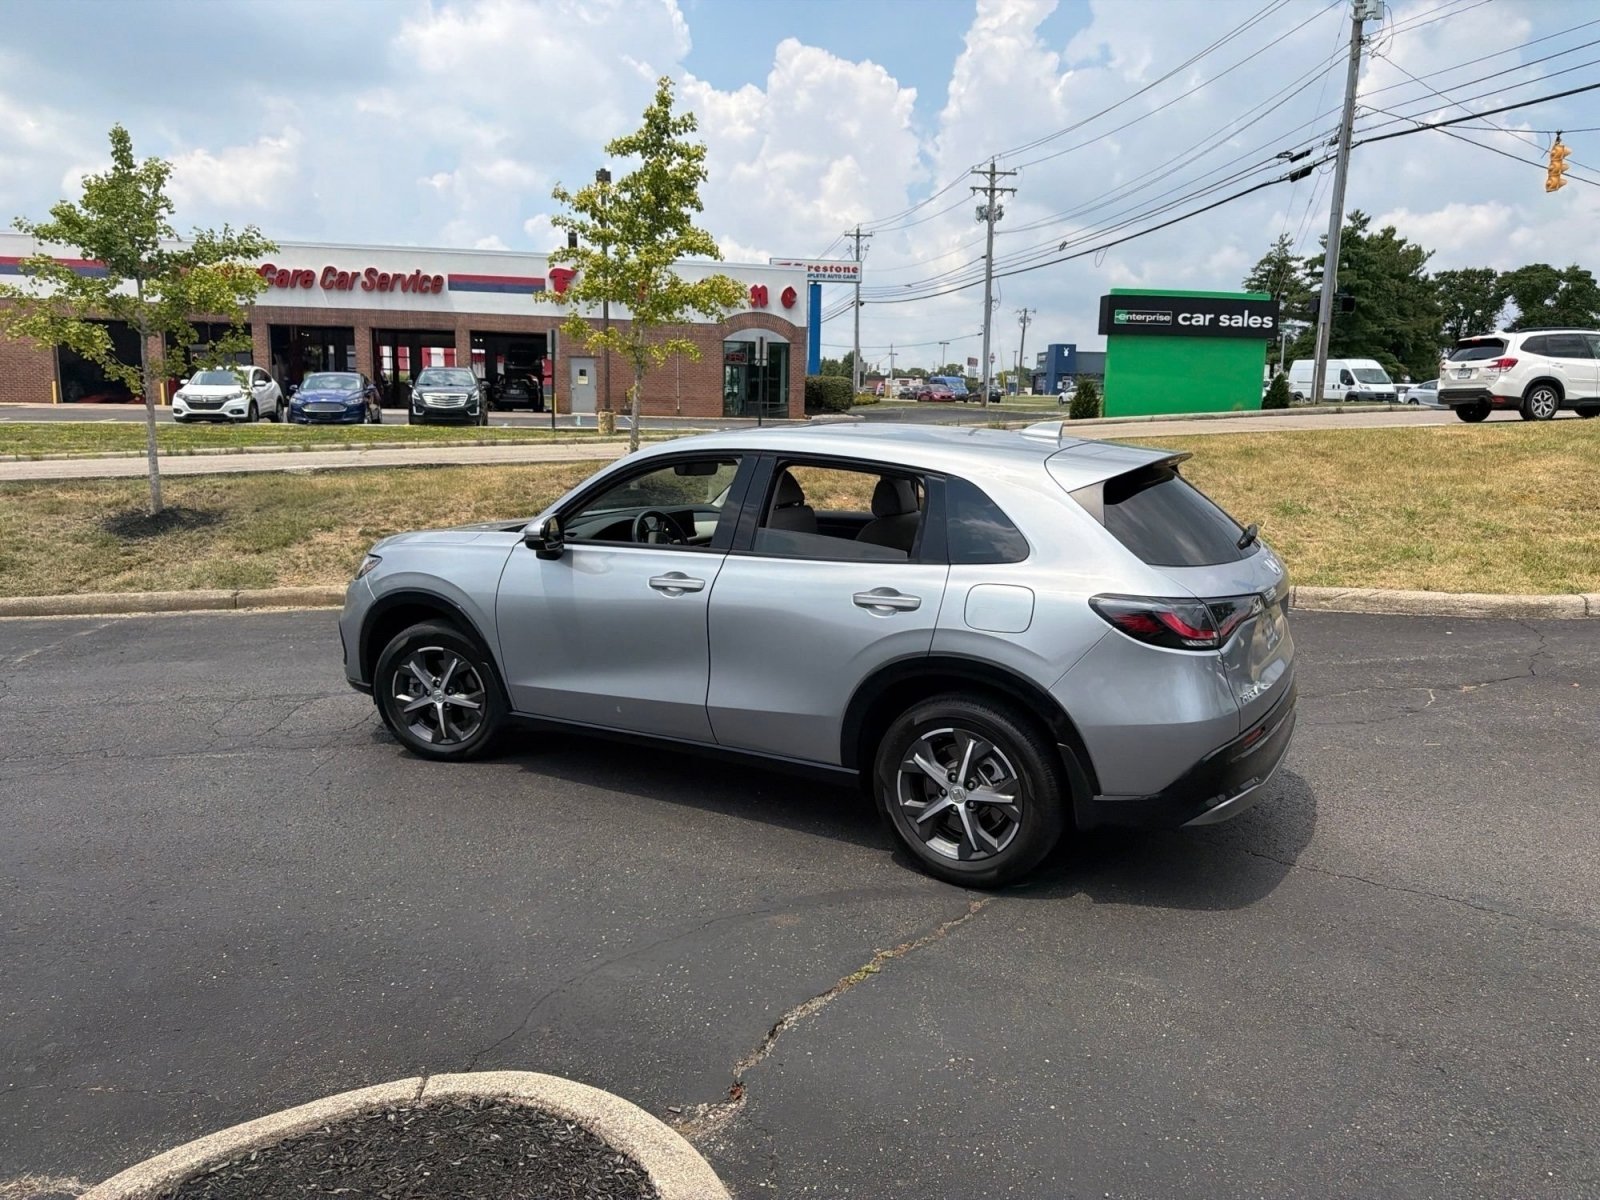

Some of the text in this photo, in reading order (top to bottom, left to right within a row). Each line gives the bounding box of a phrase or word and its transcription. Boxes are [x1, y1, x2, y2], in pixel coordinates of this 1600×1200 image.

[320, 265, 361, 291] Car
[361, 267, 444, 294] Service
[1116, 310, 1273, 328] enterprise car sales
